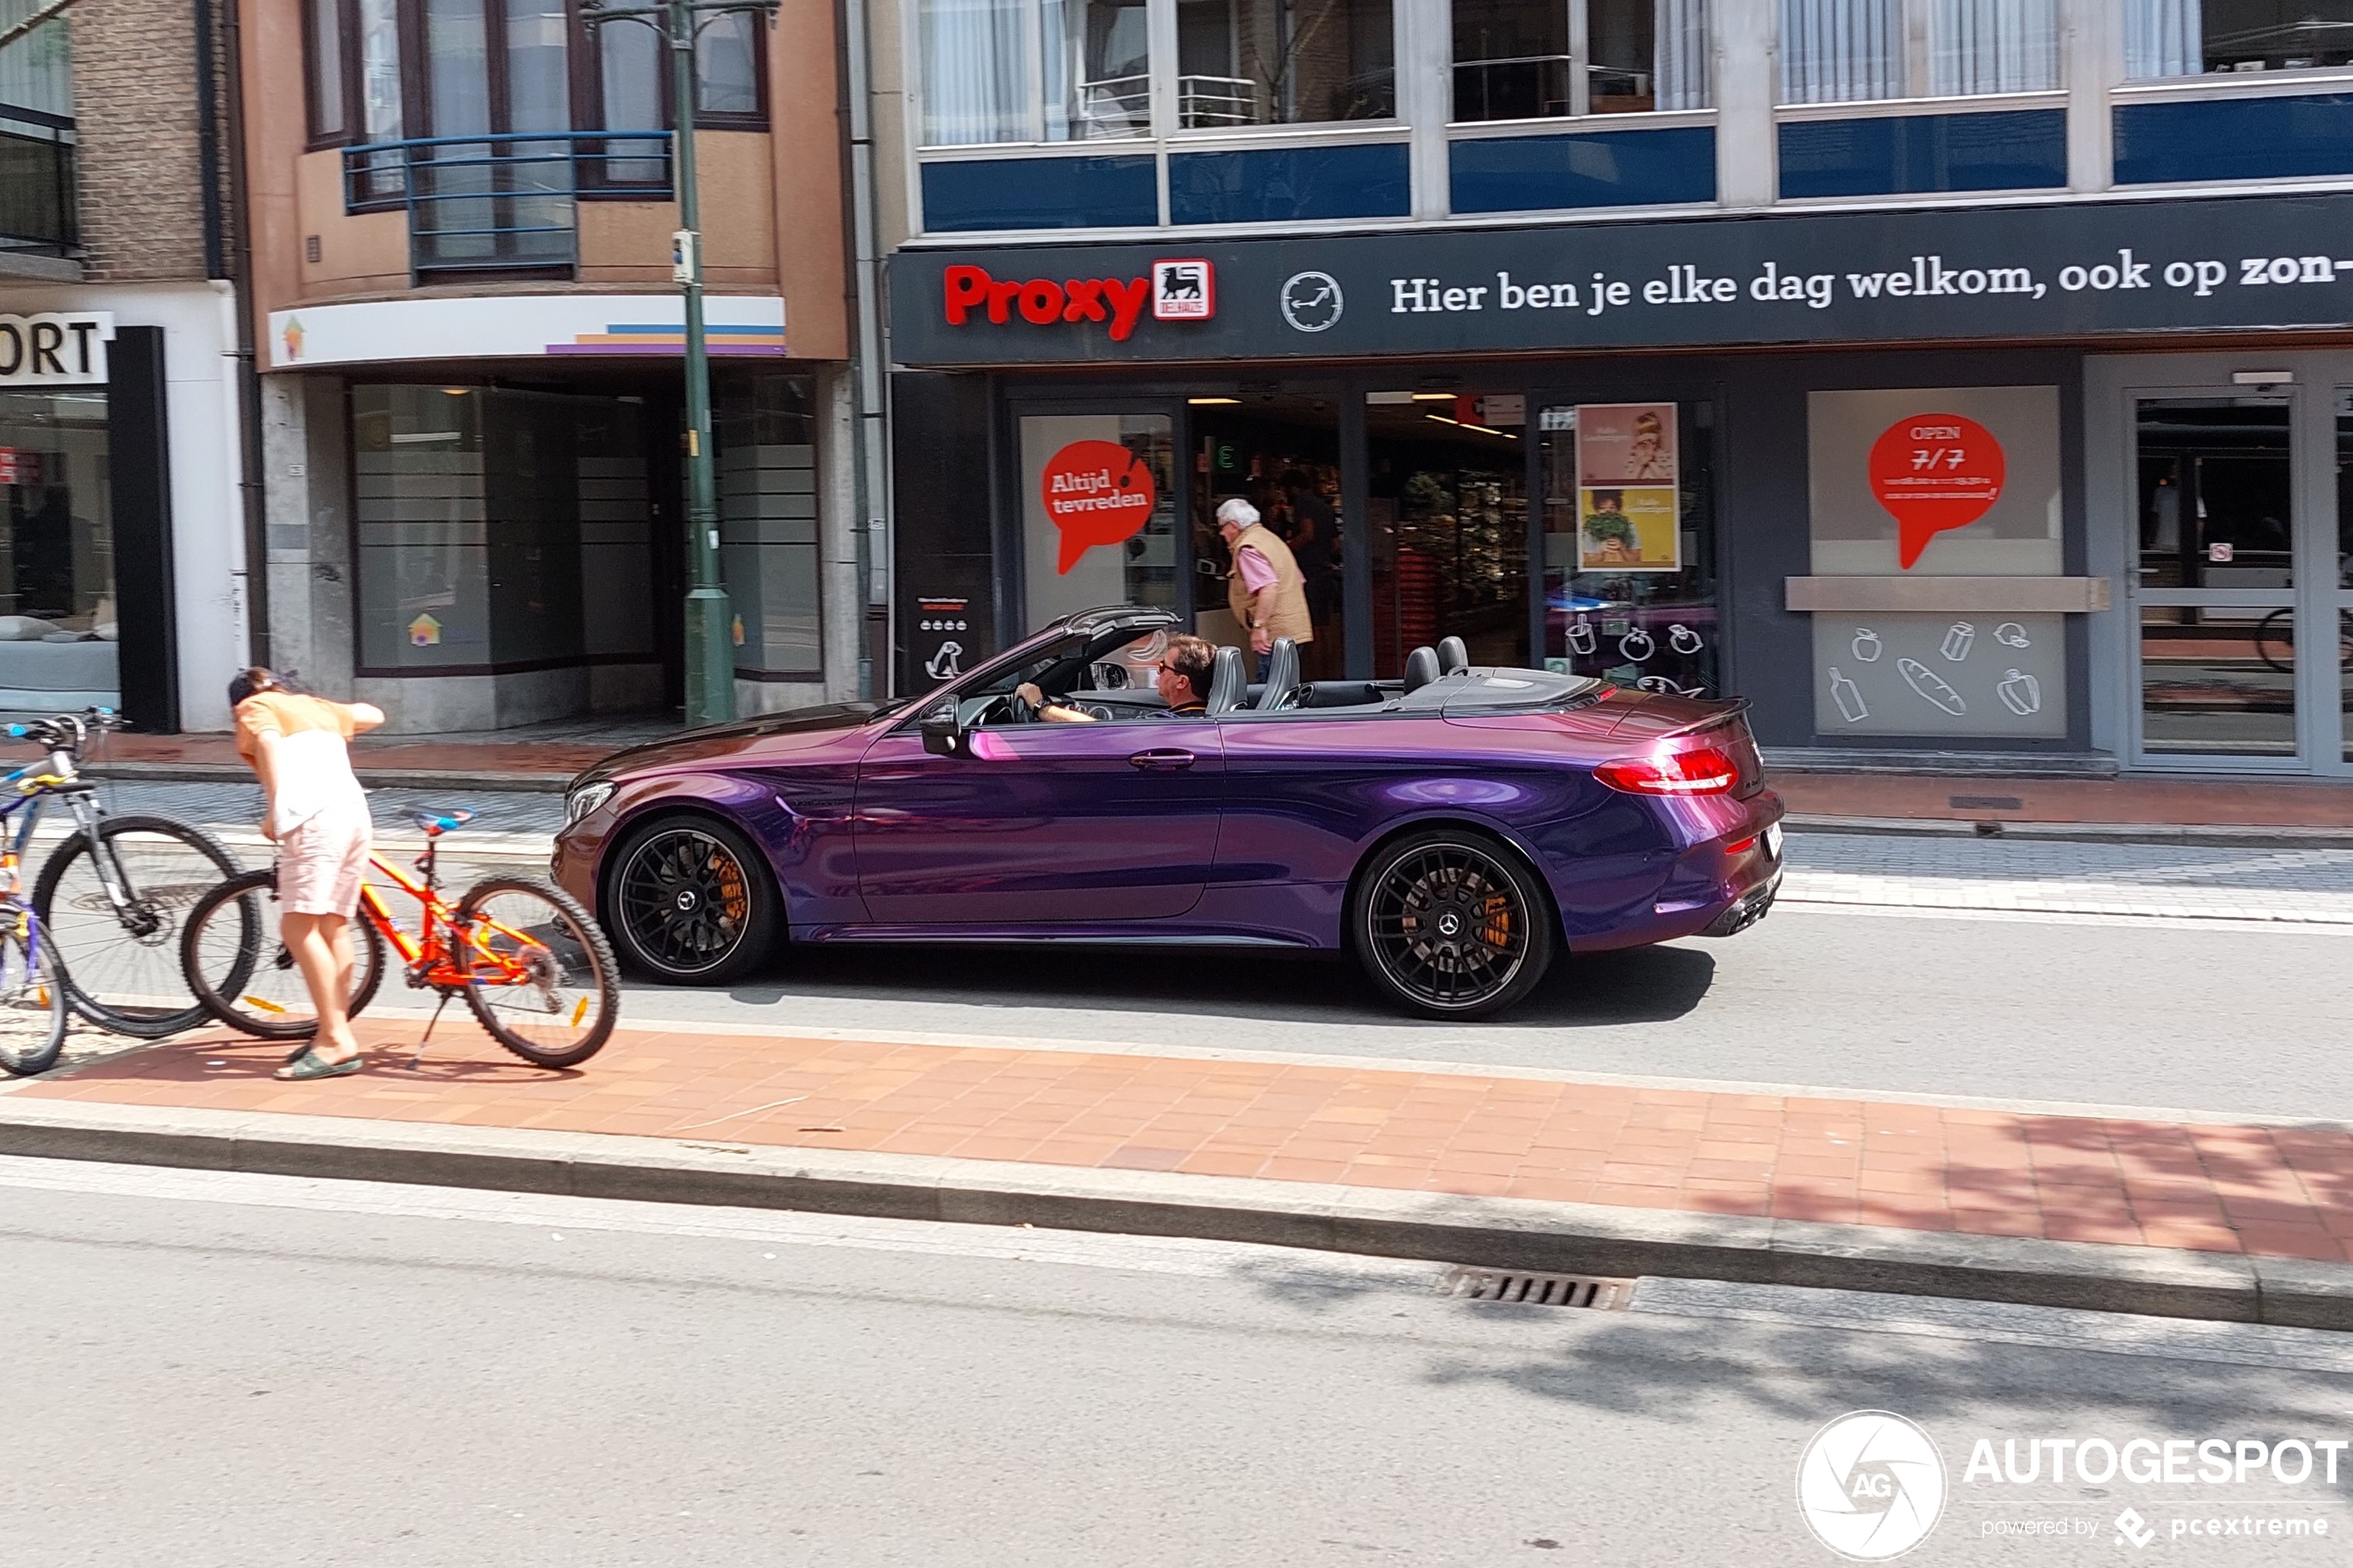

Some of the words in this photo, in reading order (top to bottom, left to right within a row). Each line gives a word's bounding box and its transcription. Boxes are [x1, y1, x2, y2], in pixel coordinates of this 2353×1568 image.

[1390, 279, 1487, 312] Hier
[1497, 272, 1579, 308] ben
[1588, 273, 1630, 315] je
[1643, 265, 1737, 304] elke
[1750, 262, 1834, 308] dag
[1846, 257, 2046, 298] welkom,
[2059, 249, 2150, 290] ook
[2164, 261, 2226, 295] op
[944, 265, 1150, 341] Proxy
[1910, 426, 1961, 440] OPEN
[1910, 447, 1966, 470] 7/7
[1051, 469, 1111, 495] Altijd
[1052, 489, 1148, 513] tevreden
